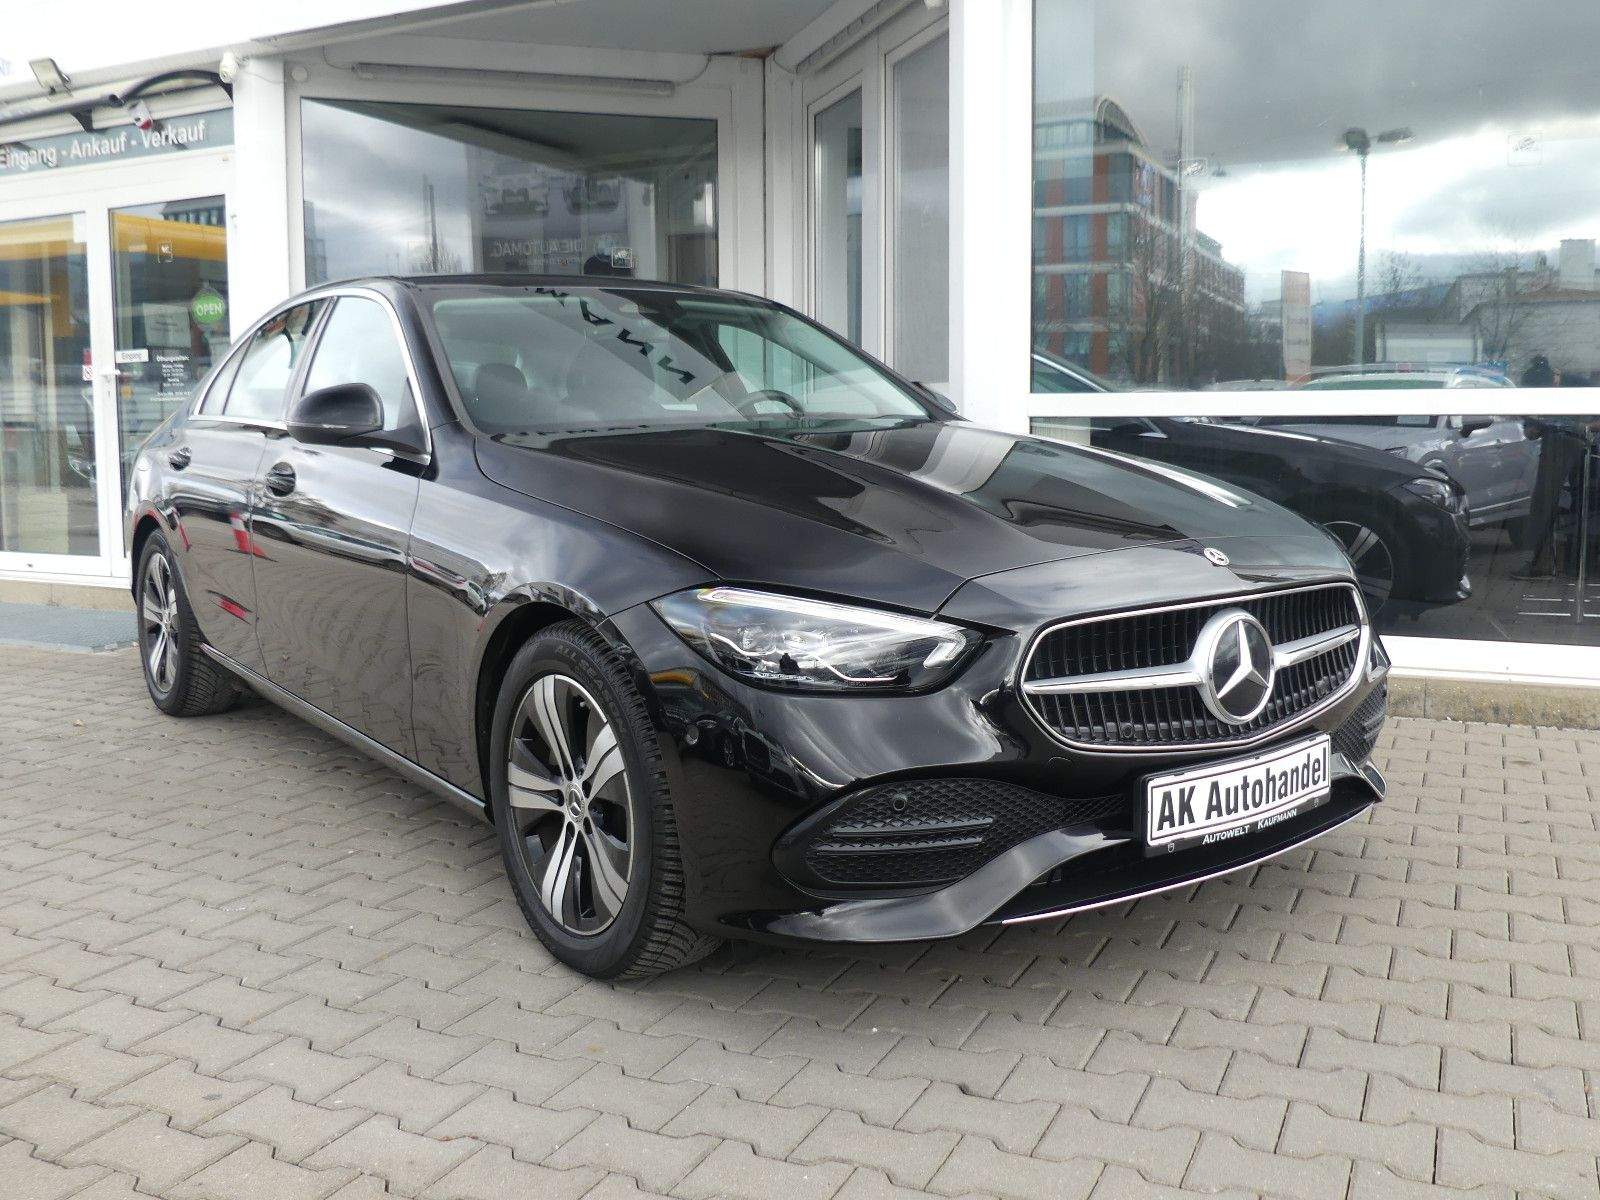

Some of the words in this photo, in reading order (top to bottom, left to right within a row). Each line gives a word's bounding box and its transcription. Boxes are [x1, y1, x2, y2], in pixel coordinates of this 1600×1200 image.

[69, 132, 128, 159] Ankauf
[141, 120, 206, 148] Verkauf
[196, 302, 223, 316] OPEN
[1157, 785, 1196, 831] AK
[1204, 747, 1327, 821] Autohandel
[1202, 825, 1250, 845] AUTOWELT
[1257, 809, 1298, 829] KAUFMANN
